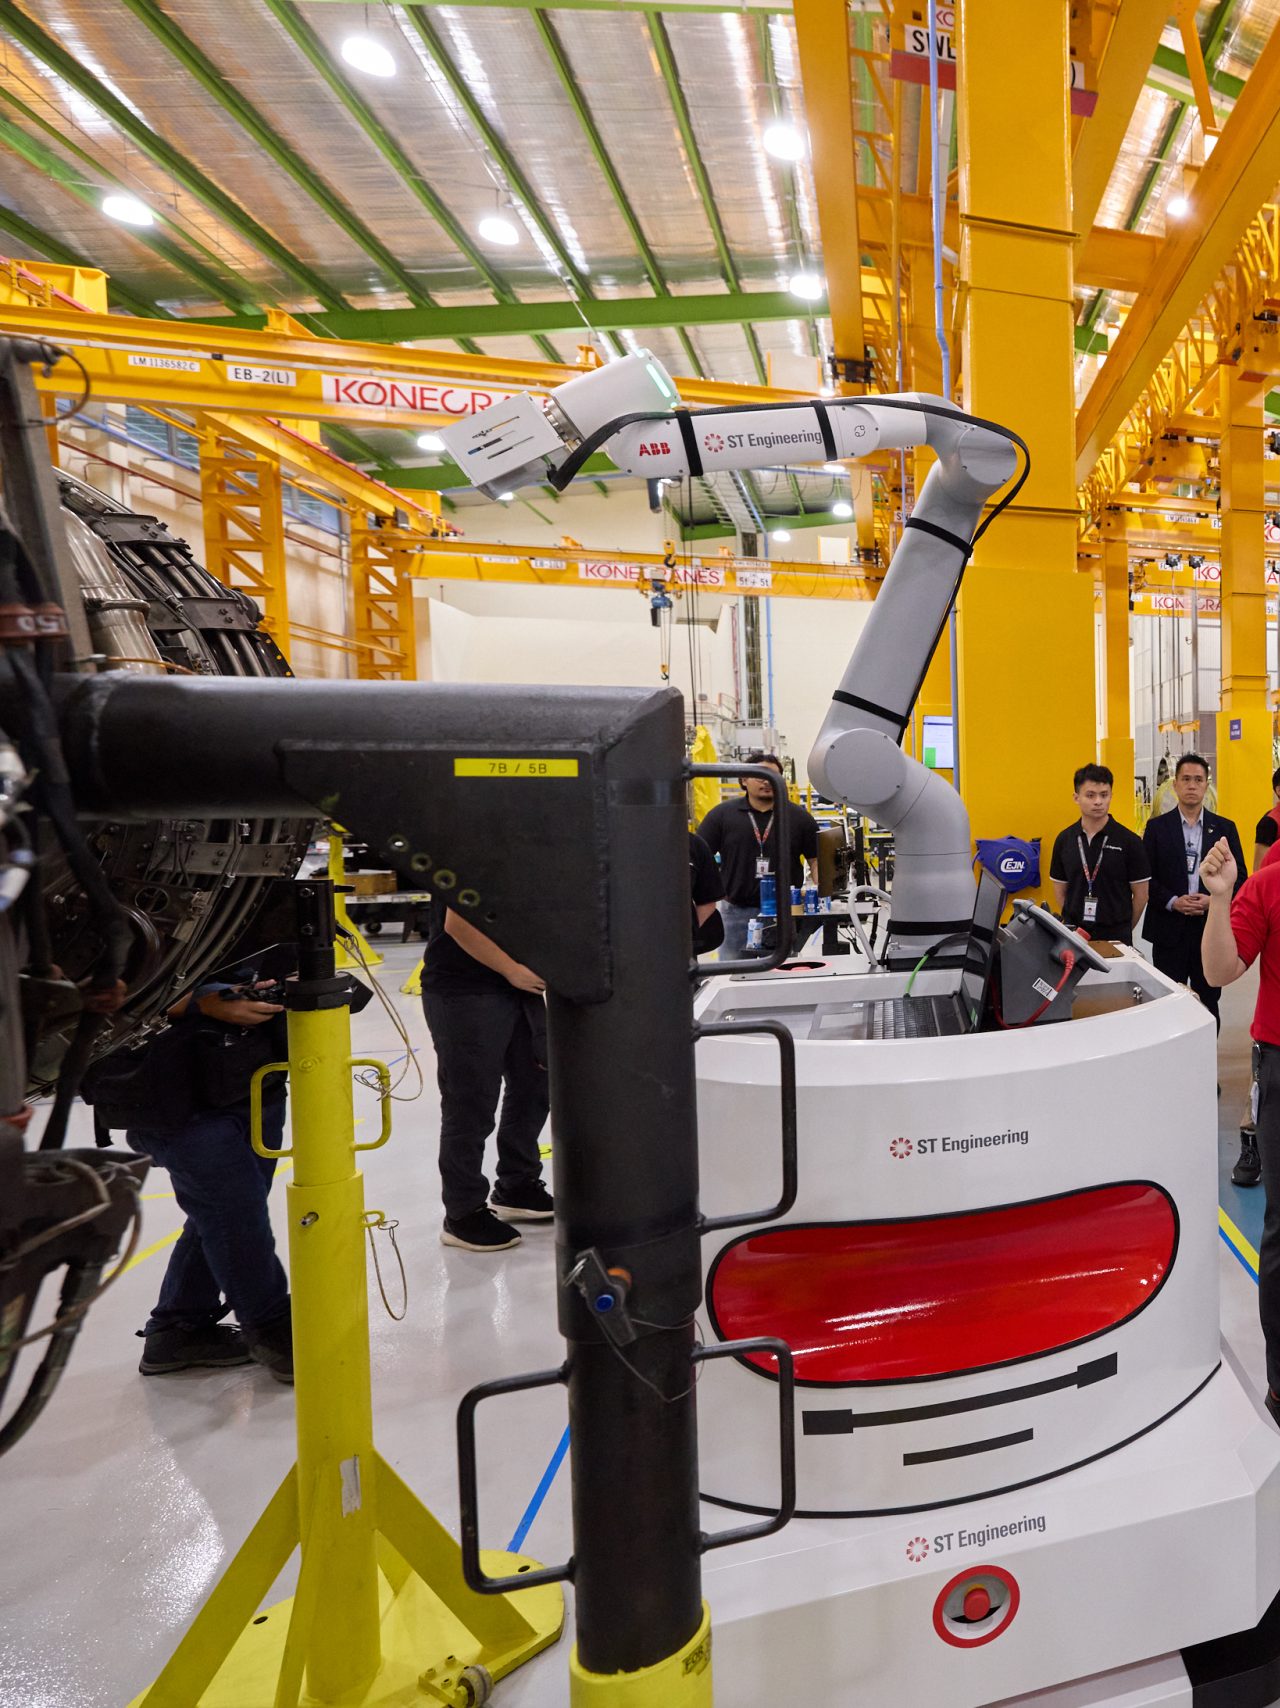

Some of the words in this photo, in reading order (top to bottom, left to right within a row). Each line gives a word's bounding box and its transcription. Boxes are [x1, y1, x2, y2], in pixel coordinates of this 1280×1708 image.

[132, 356, 147, 366] LM
[150, 357, 188, 370] 1136582
[188, 362, 195, 371] C
[234, 367, 290, 385] EB-2(L)
[727, 434, 744, 449] ST
[749, 429, 823, 448] Engineering
[638, 441, 671, 457] ABB
[739, 576, 748, 586] 5t
[760, 578, 769, 587] 5t
[488, 762, 508, 774] 7B
[528, 762, 547, 774] 5B
[1000, 857, 1025, 873] CEJN
[917, 1138, 937, 1154] ST
[942, 1129, 1029, 1154] Engineering
[933, 1533, 954, 1554] ST
[958, 1515, 1046, 1547] Engineering
